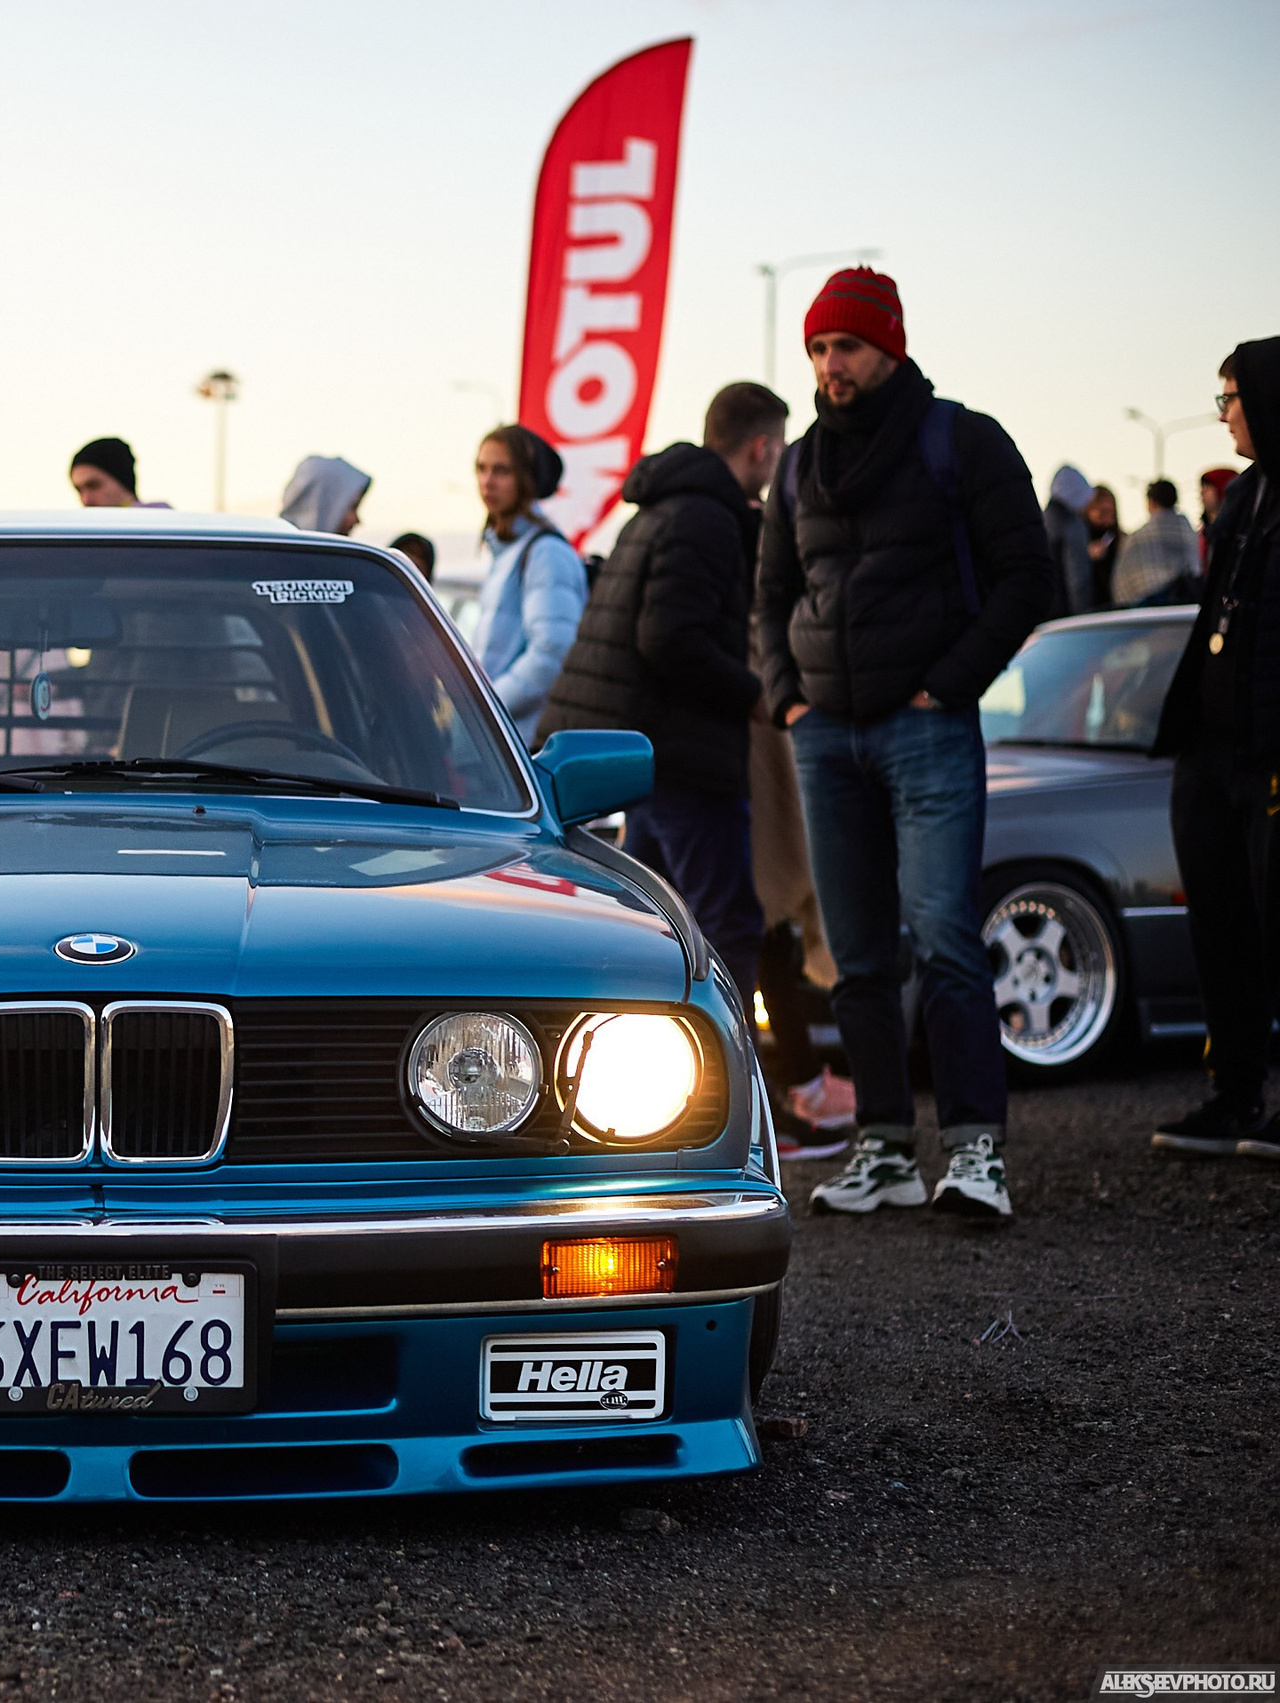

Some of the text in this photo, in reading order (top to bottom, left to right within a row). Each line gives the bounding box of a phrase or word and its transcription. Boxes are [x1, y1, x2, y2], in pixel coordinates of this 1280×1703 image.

[542, 137, 657, 533] MOTUL
[253, 581, 353, 595] TSUNAMI
[271, 591, 345, 603] PICNIC
[37, 1264, 169, 1279] THE SELECT ELITE
[17, 1273, 198, 1315] California
[517, 1361, 628, 1391] Hella
